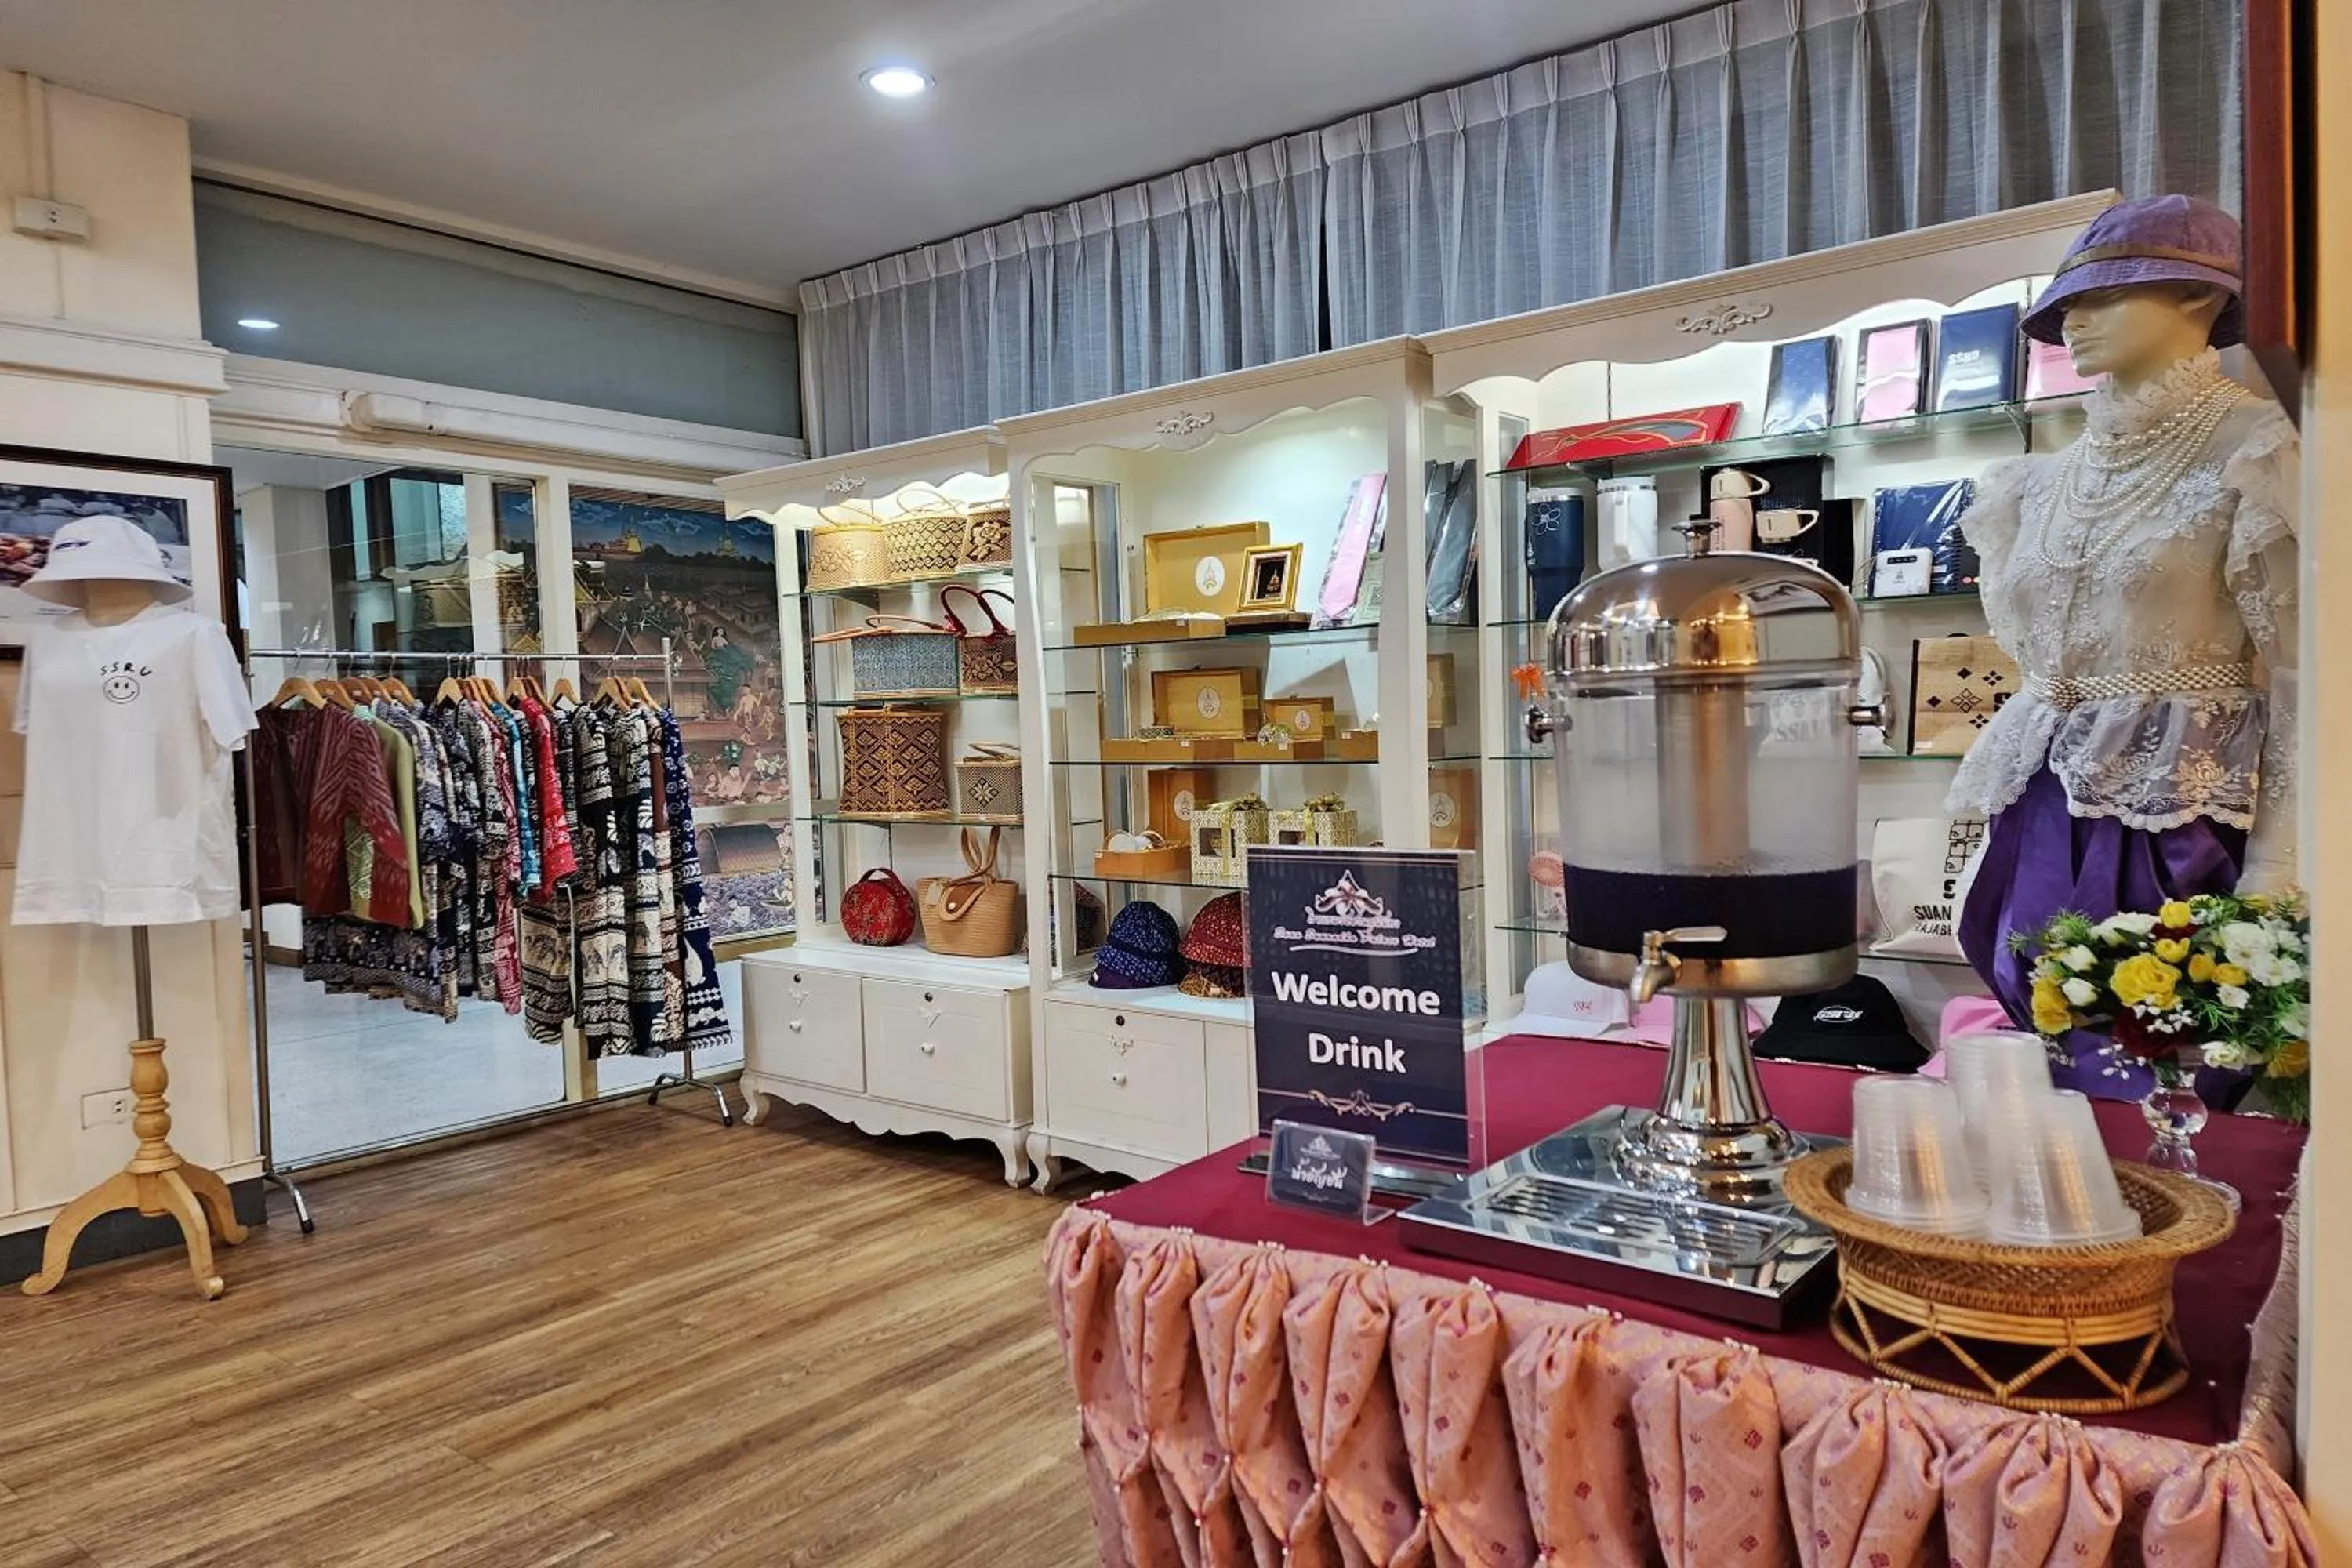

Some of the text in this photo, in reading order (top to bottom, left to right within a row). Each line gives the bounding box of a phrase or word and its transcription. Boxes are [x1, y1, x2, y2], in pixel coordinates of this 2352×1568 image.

[1913, 905, 1952, 920] SUAN
[1271, 971, 1441, 1015] Welcome
[1308, 1032, 1406, 1073] Drink
